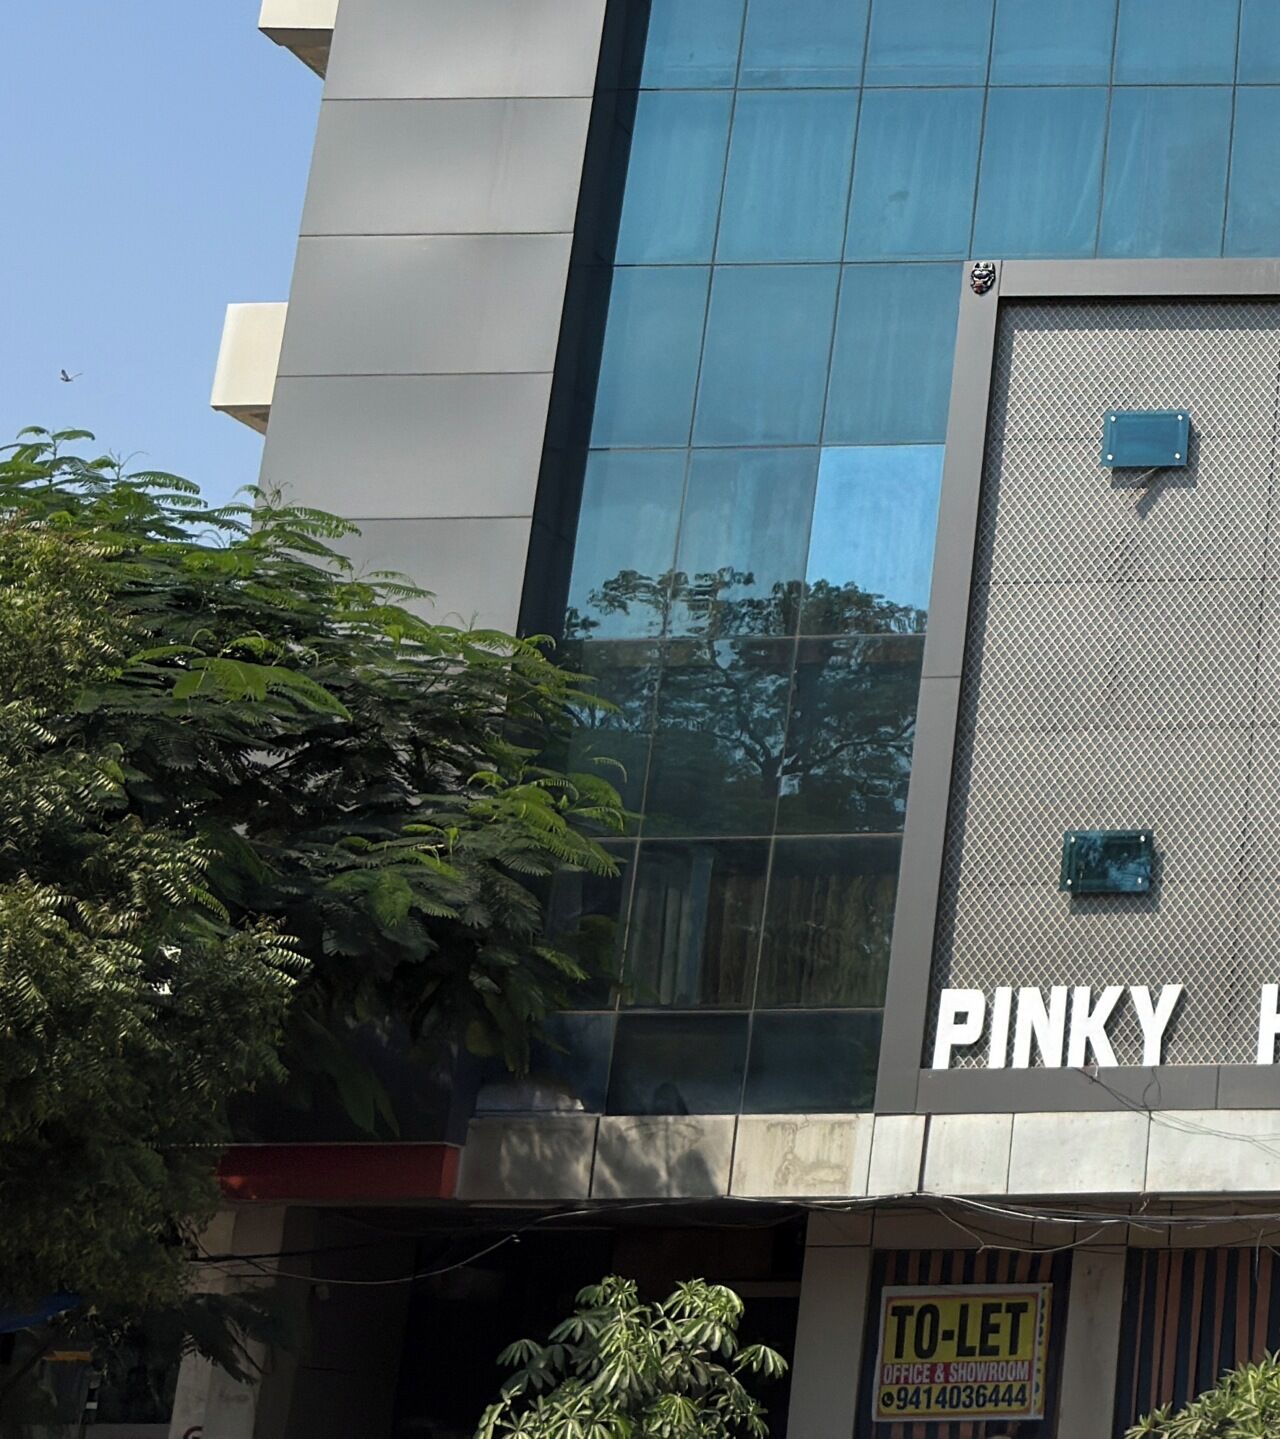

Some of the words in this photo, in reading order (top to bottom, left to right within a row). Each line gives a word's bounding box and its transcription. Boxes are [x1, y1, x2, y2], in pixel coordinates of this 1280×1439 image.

[931, 983, 1184, 1070] PINKY
[891, 1302, 1029, 1359] TO-LET
[883, 1363, 931, 1385] OFFICE
[934, 1363, 945, 1384] &
[949, 1361, 1029, 1383] SHOWROOM
[896, 1384, 1028, 1410] 9414036444
